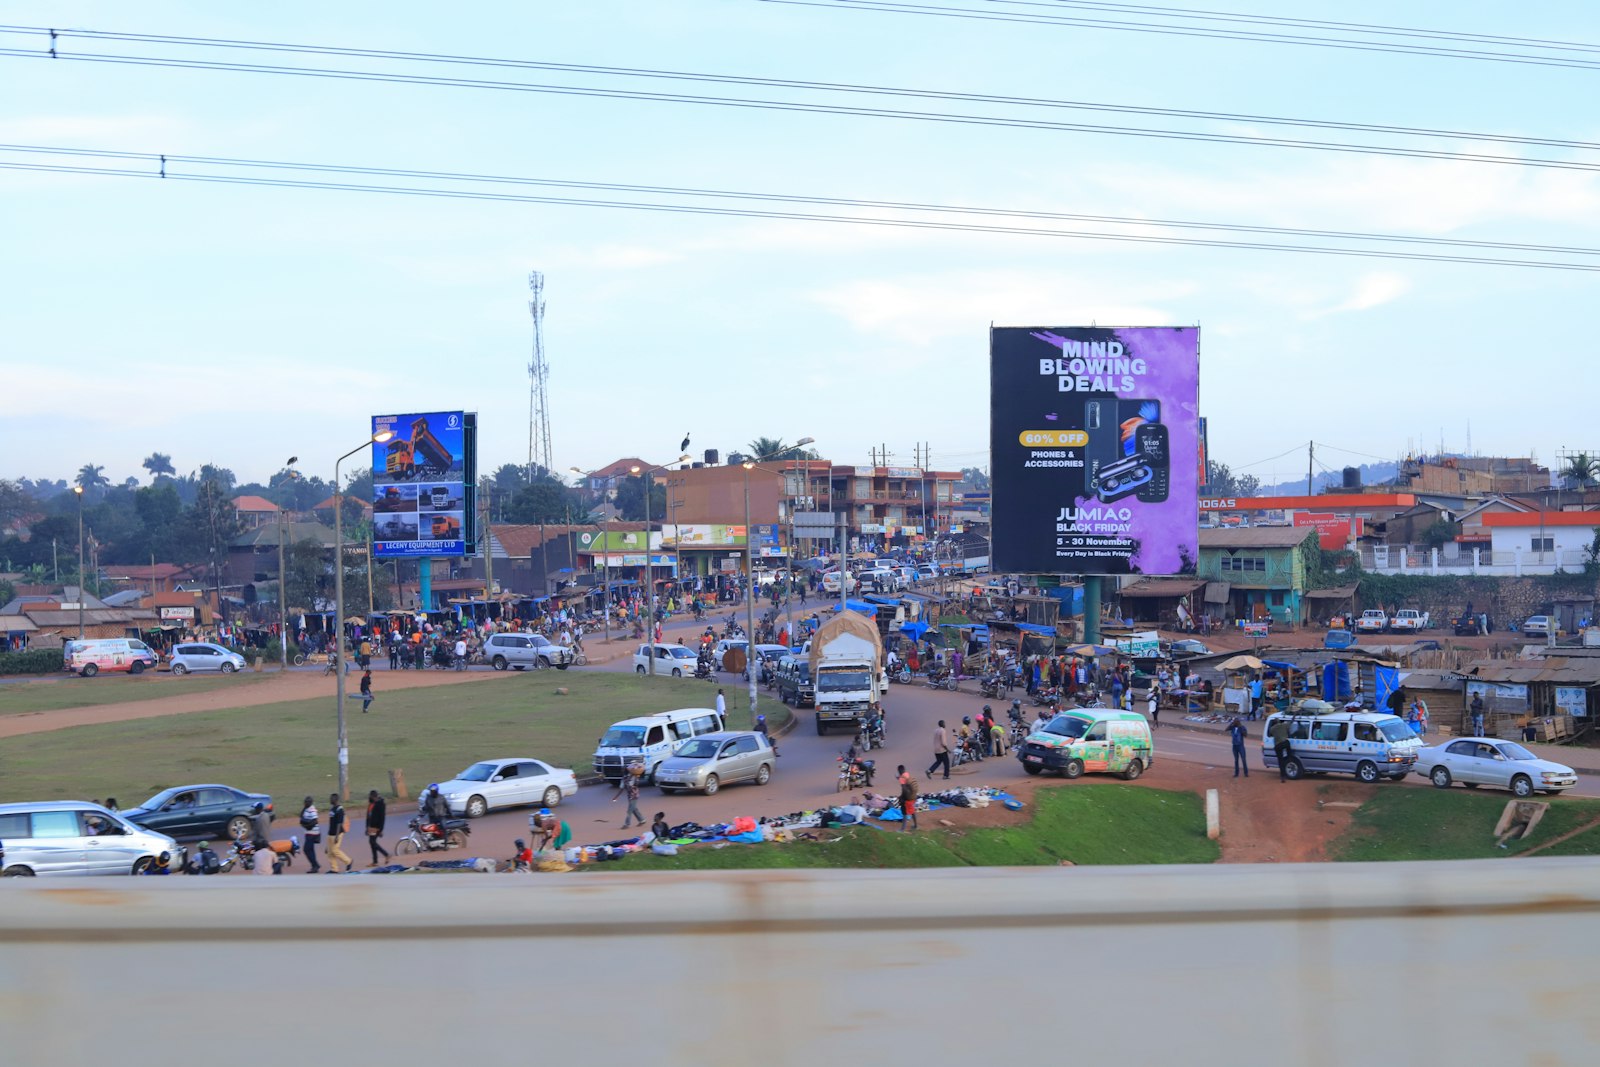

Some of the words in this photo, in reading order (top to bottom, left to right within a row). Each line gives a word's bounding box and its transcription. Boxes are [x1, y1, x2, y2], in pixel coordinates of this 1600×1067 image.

[1063, 341, 1123, 358] MIND
[1039, 358, 1147, 375] BLOWING
[1058, 375, 1136, 392] DEALS
[1025, 433, 1054, 443] 60%
[1058, 433, 1085, 443] OFF
[1024, 460, 1084, 468] ACCESSORIES
[1056, 523, 1092, 532] BLACK
[1094, 523, 1132, 532] FRIDAY
[408, 541, 443, 549] EQUIPMENT
[1086, 537, 1132, 545] November
